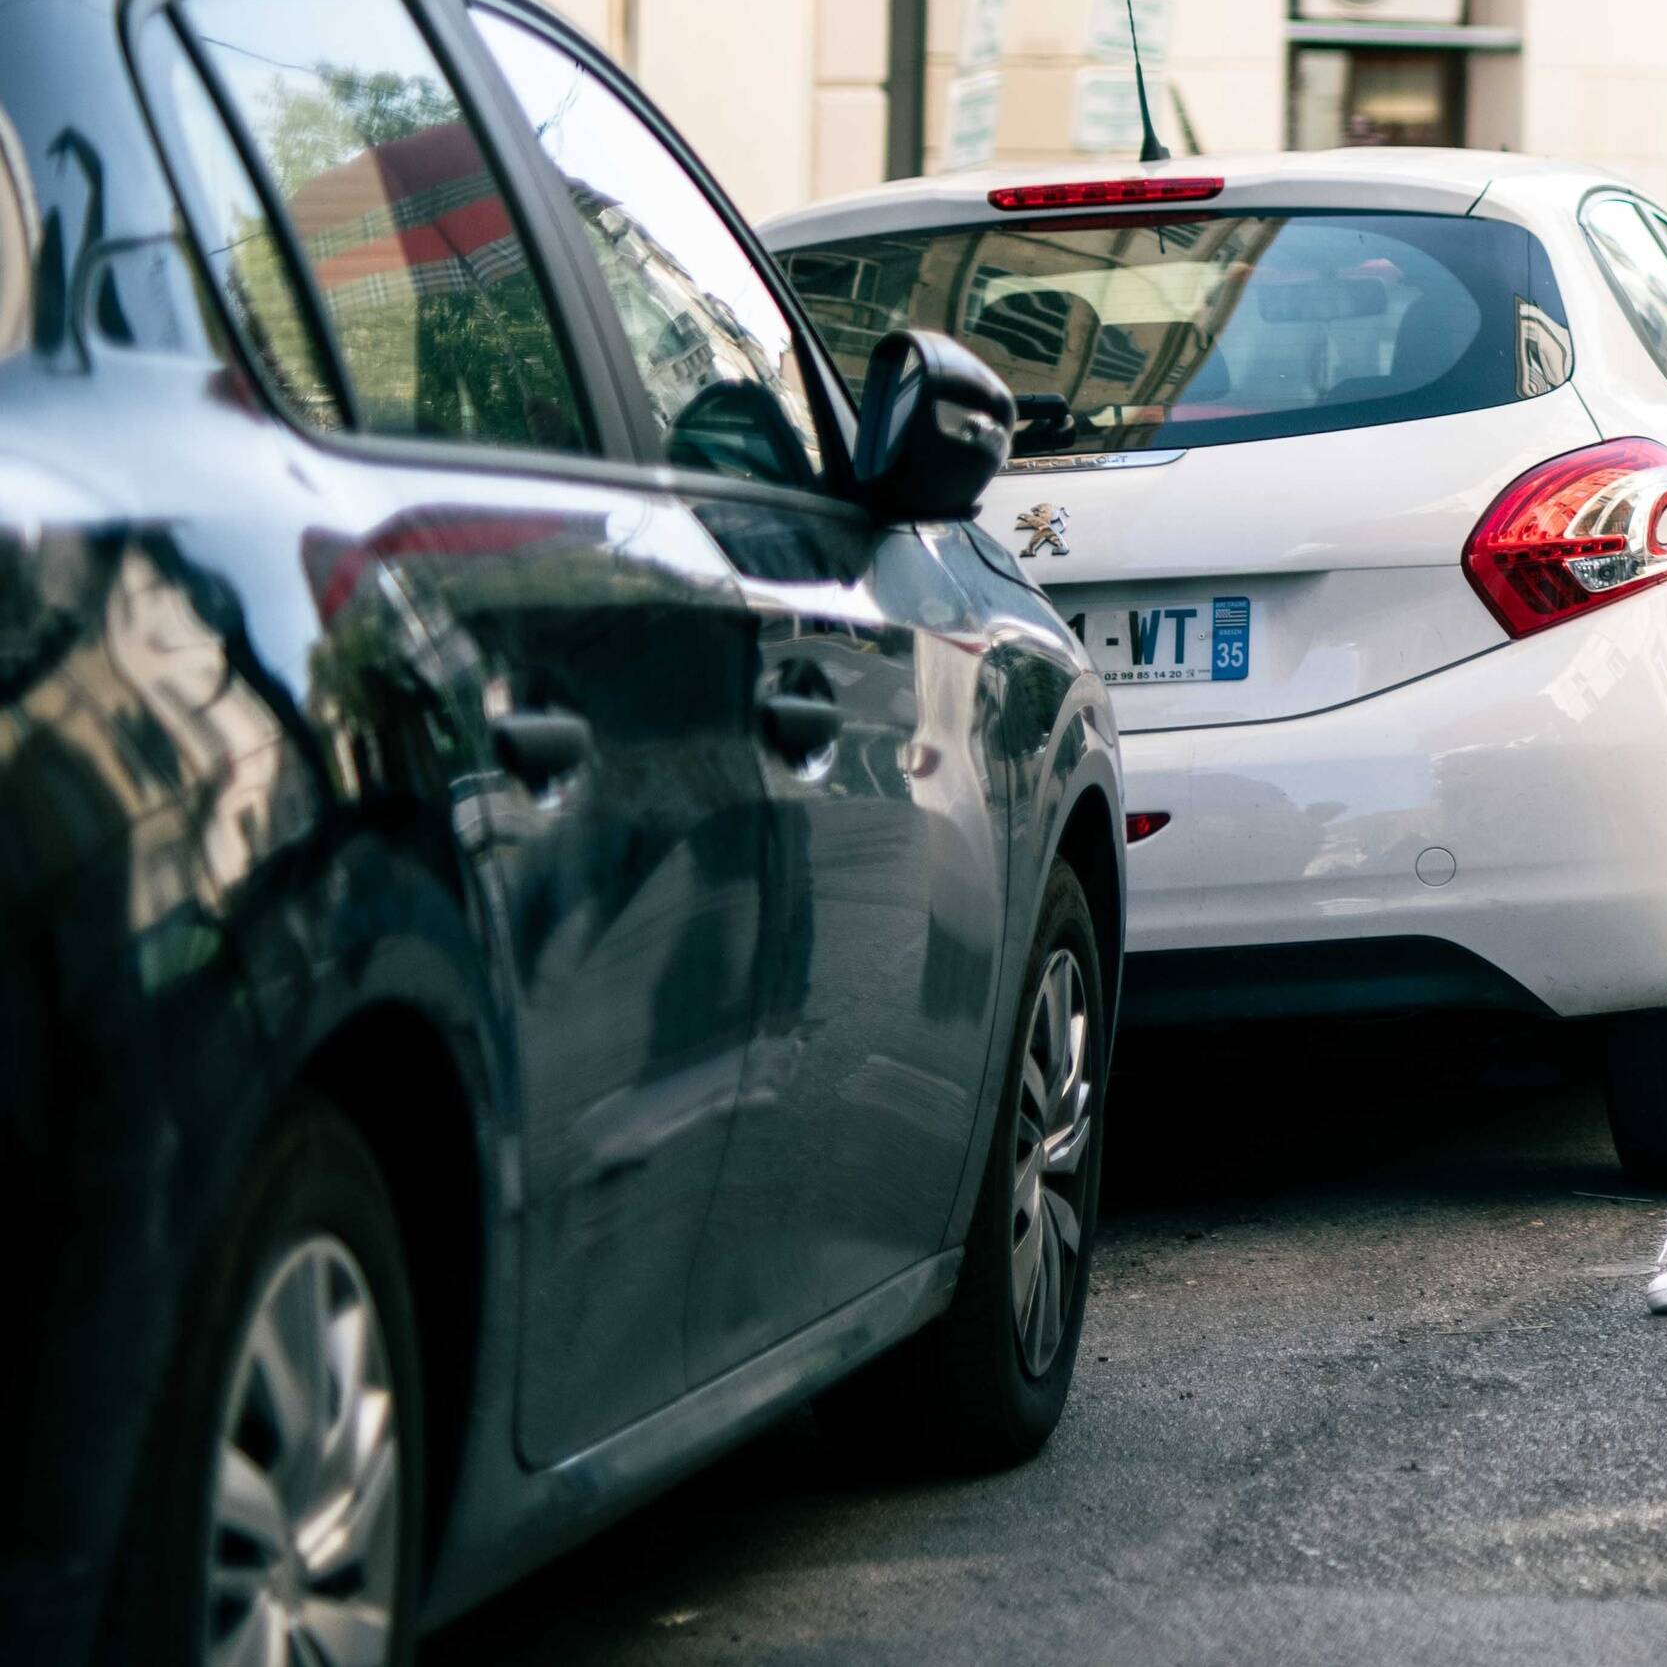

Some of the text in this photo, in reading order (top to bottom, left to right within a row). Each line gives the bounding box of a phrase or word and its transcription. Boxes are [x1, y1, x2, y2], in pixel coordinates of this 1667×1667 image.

[1216, 641, 1244, 668] 35
[1104, 673, 1118, 681] 02
[1120, 672, 1134, 680] 99
[1154, 670, 1166, 679] 14
